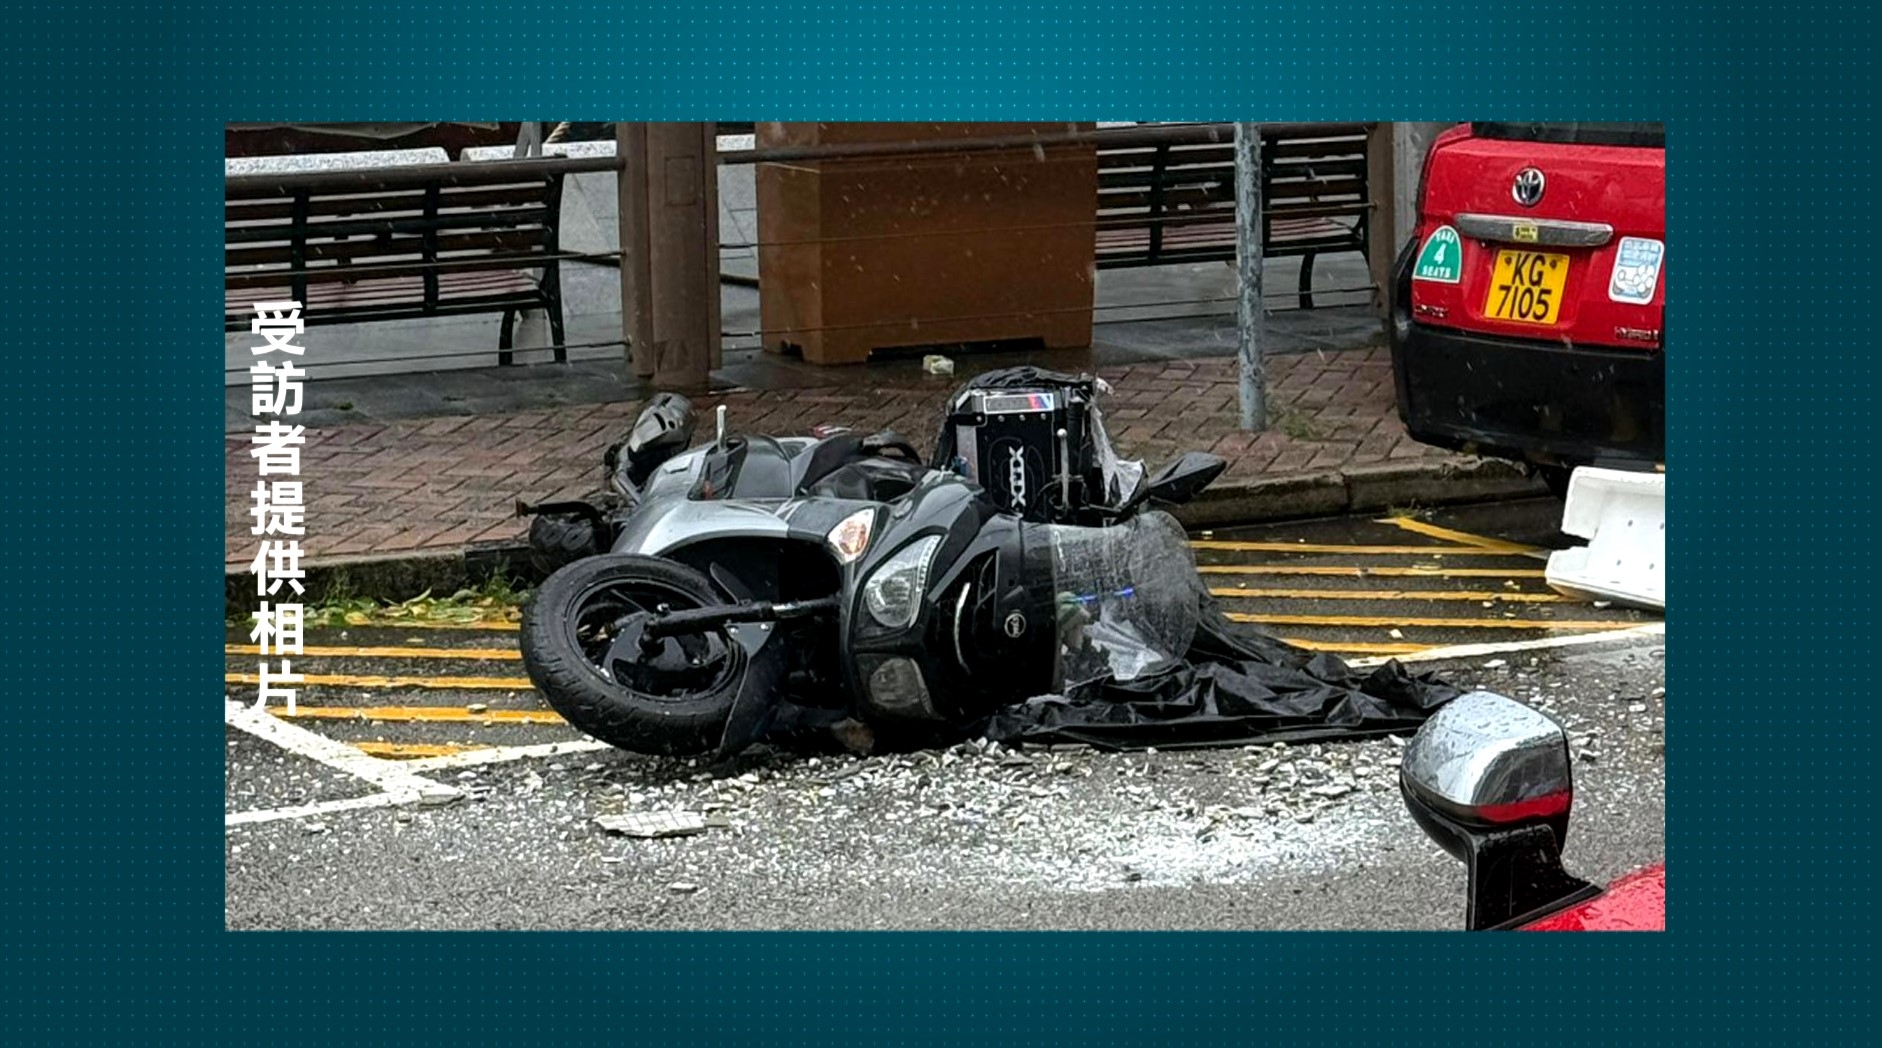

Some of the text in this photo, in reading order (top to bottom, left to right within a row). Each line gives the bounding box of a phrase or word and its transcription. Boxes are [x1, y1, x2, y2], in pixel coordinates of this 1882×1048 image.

[1435, 230, 1455, 244] TAXI
[1433, 243, 1447, 265] 4
[1422, 265, 1451, 278] SEATS
[1511, 252, 1546, 287] KG
[1495, 284, 1552, 321] 7105
